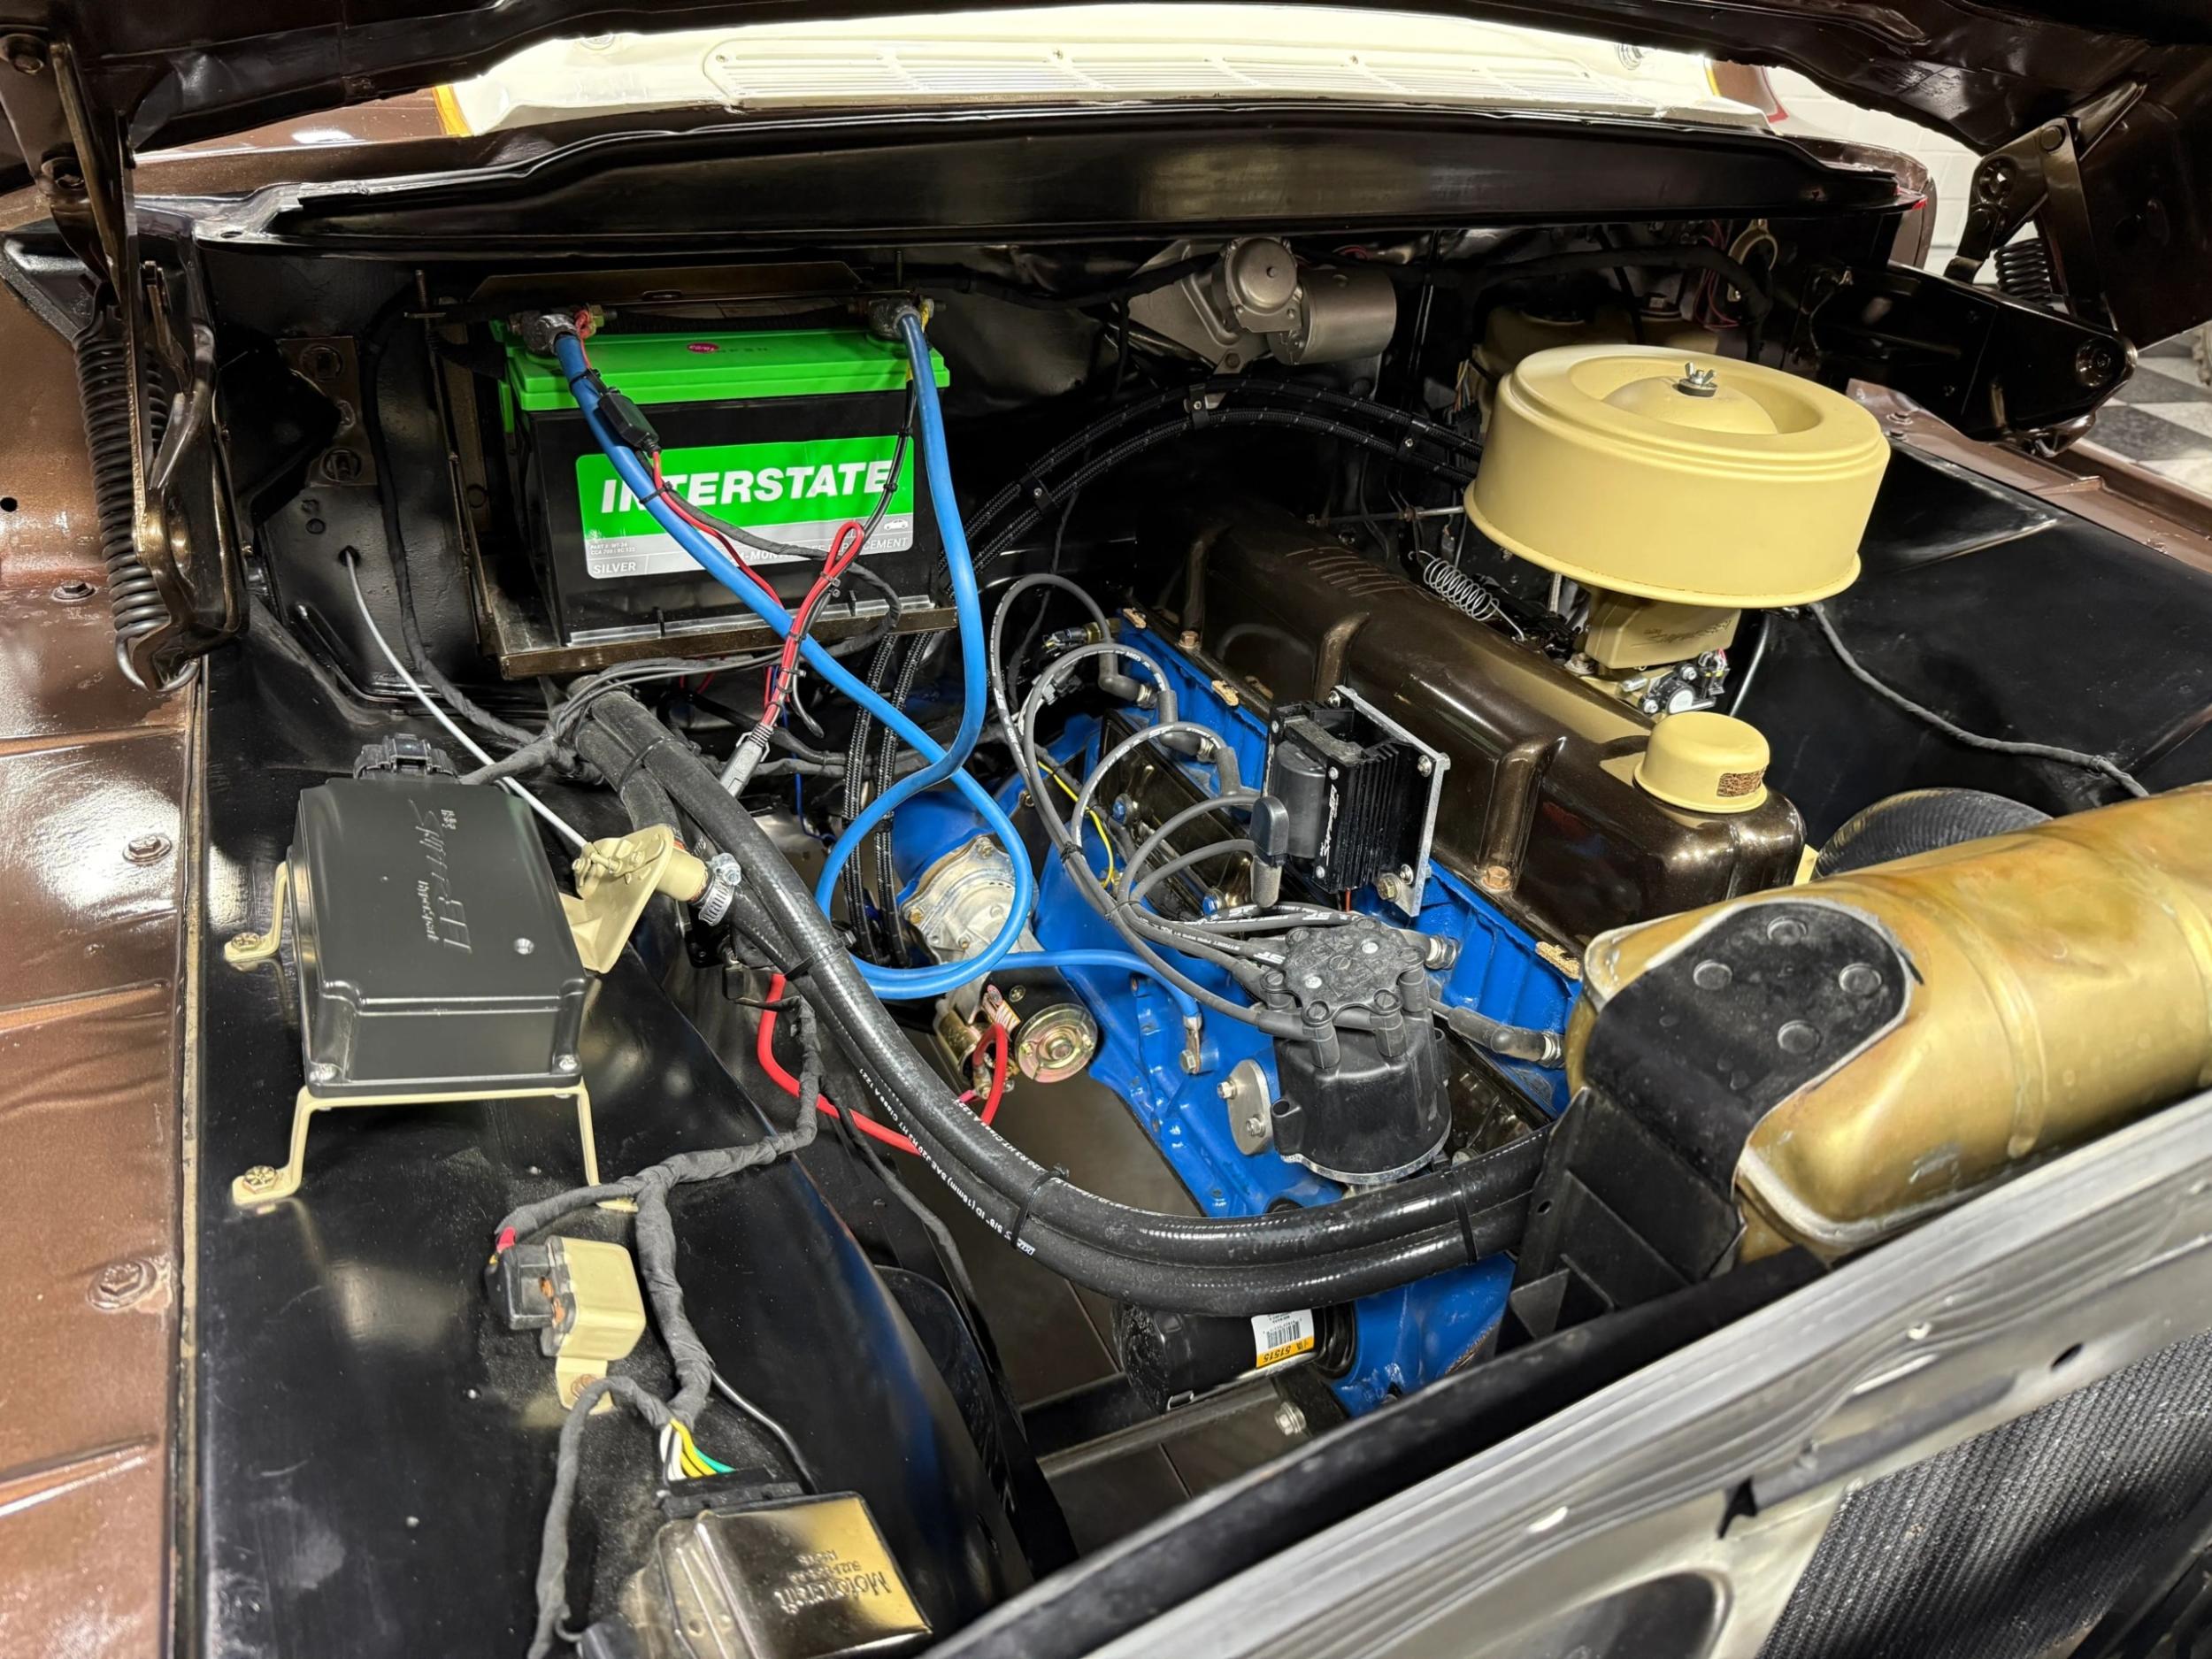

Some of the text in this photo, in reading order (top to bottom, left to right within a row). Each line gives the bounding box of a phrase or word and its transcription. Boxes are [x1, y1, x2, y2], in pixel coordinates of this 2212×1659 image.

[594, 561, 636, 574] SILVER
[858, 1067, 874, 1088] 1221
[879, 1096, 899, 1122] Class
[897, 1121, 910, 1135] HT
[982, 1123, 1002, 1141] Class
[918, 1147, 933, 1164] J20
[1002, 1141, 1016, 1154] HT
[931, 1160, 947, 1180] SAE
[975, 1206, 987, 1220] ID
[1263, 1345, 1291, 1363] 51515
[773, 1571, 892, 1615] Motorcraft
